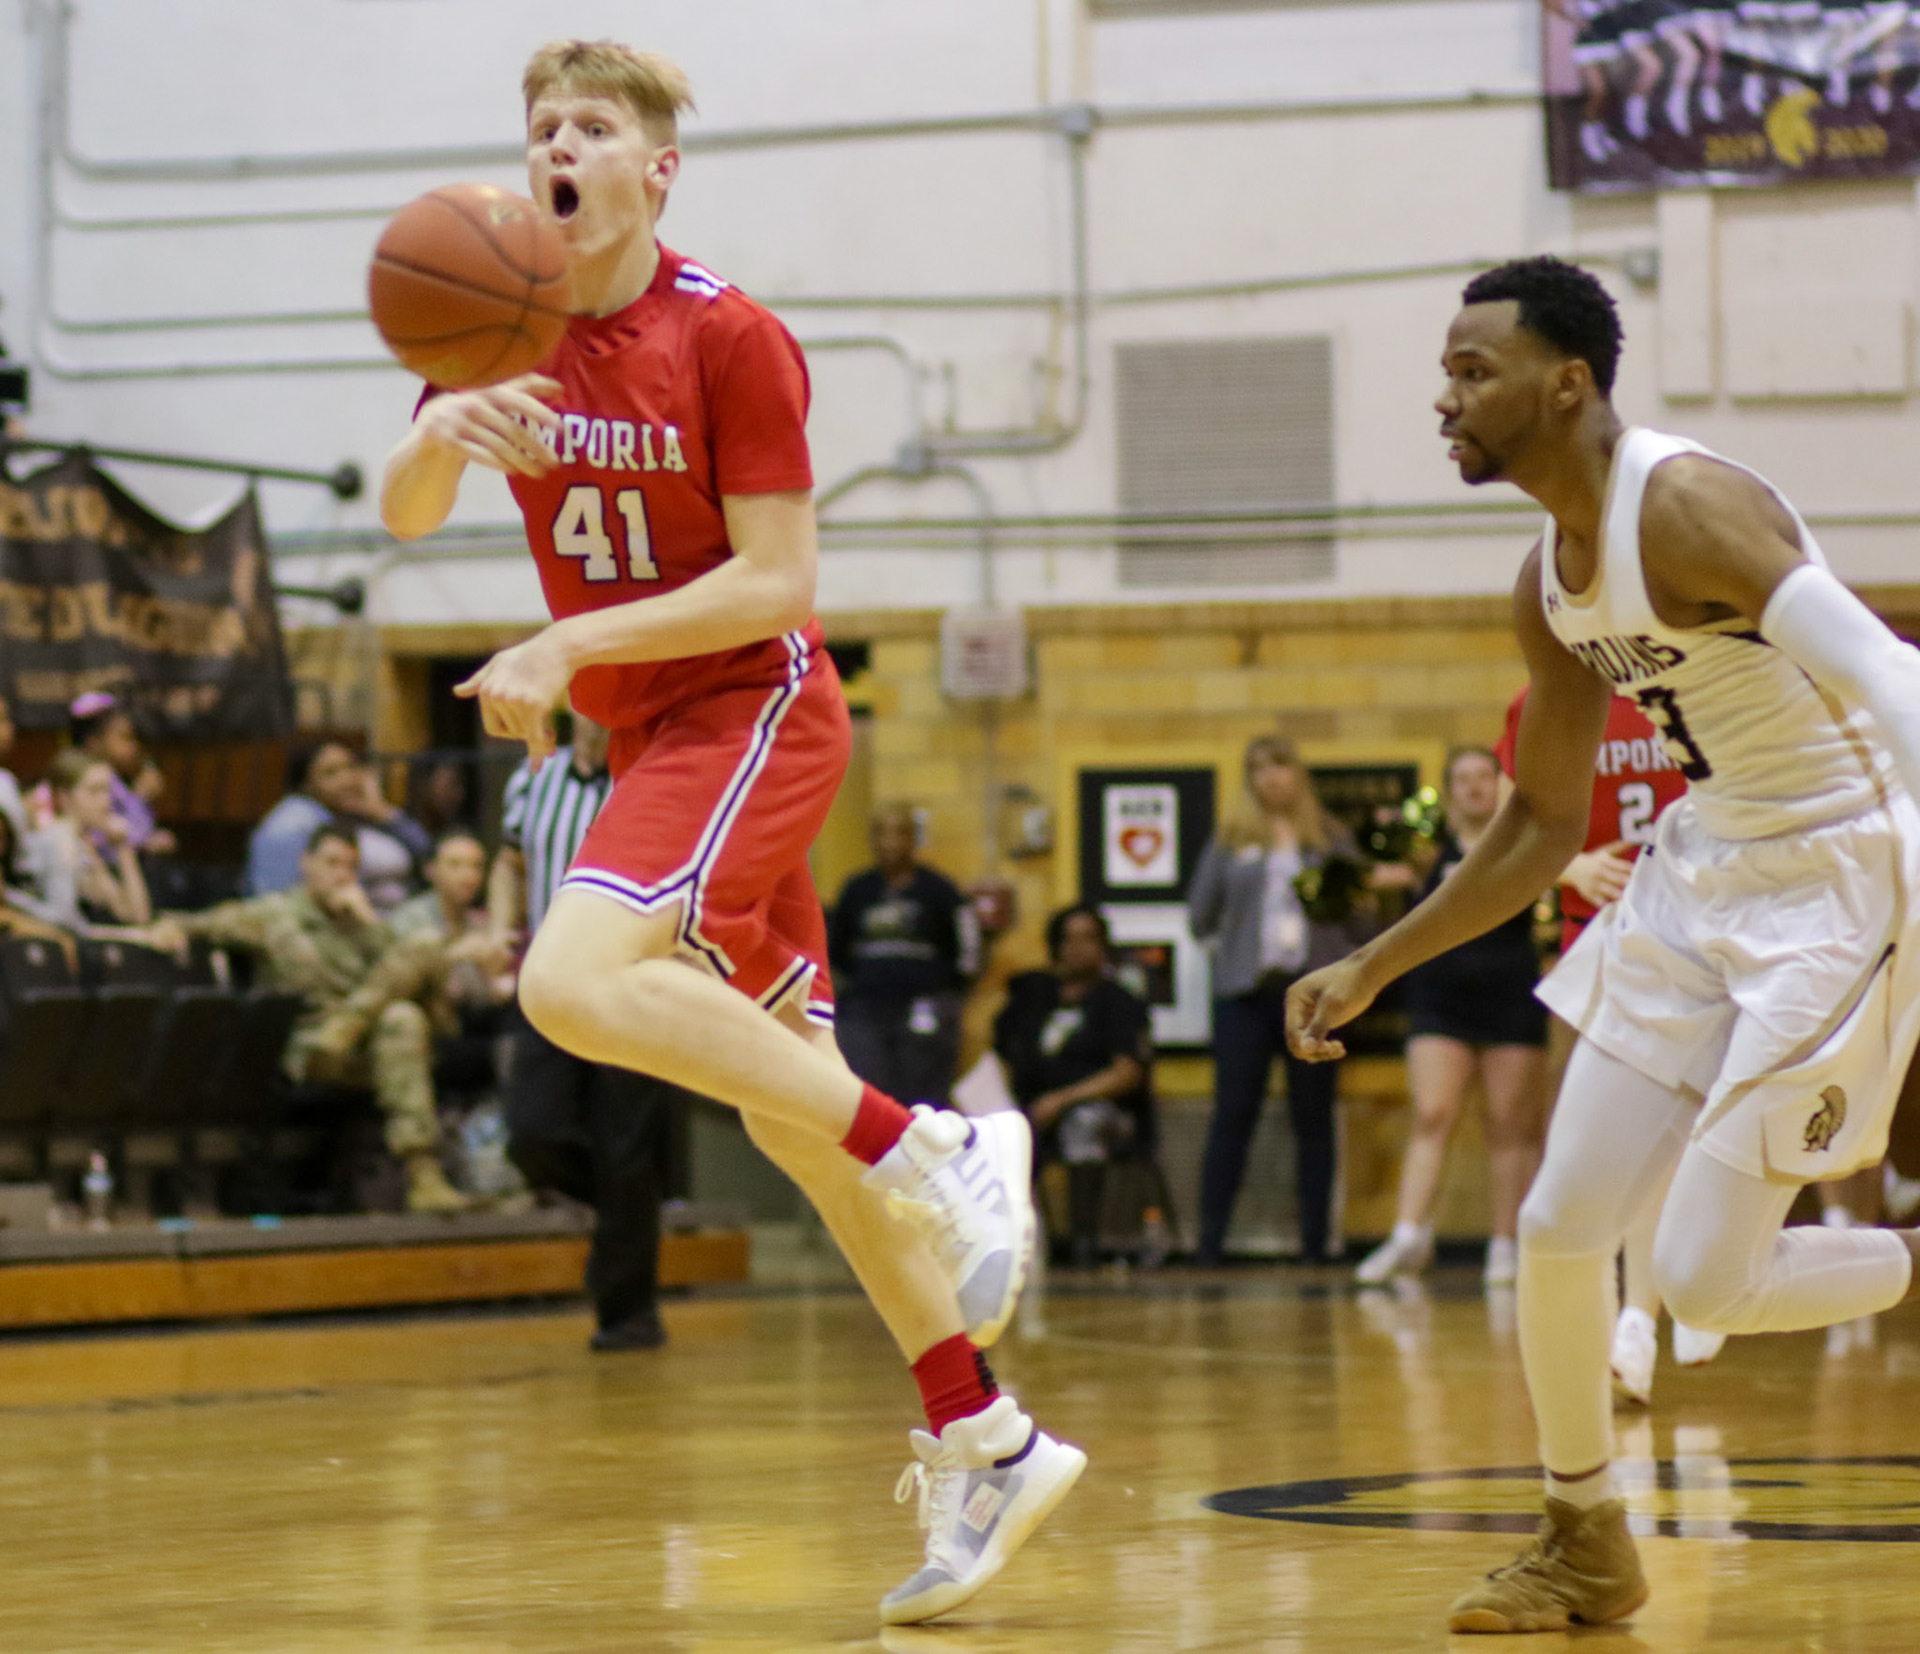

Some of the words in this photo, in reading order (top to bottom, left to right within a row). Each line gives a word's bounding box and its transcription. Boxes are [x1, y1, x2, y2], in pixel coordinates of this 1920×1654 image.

[513, 412, 688, 473] MPORIA
[551, 484, 662, 583] 41
[1617, 781, 1656, 845] 2
